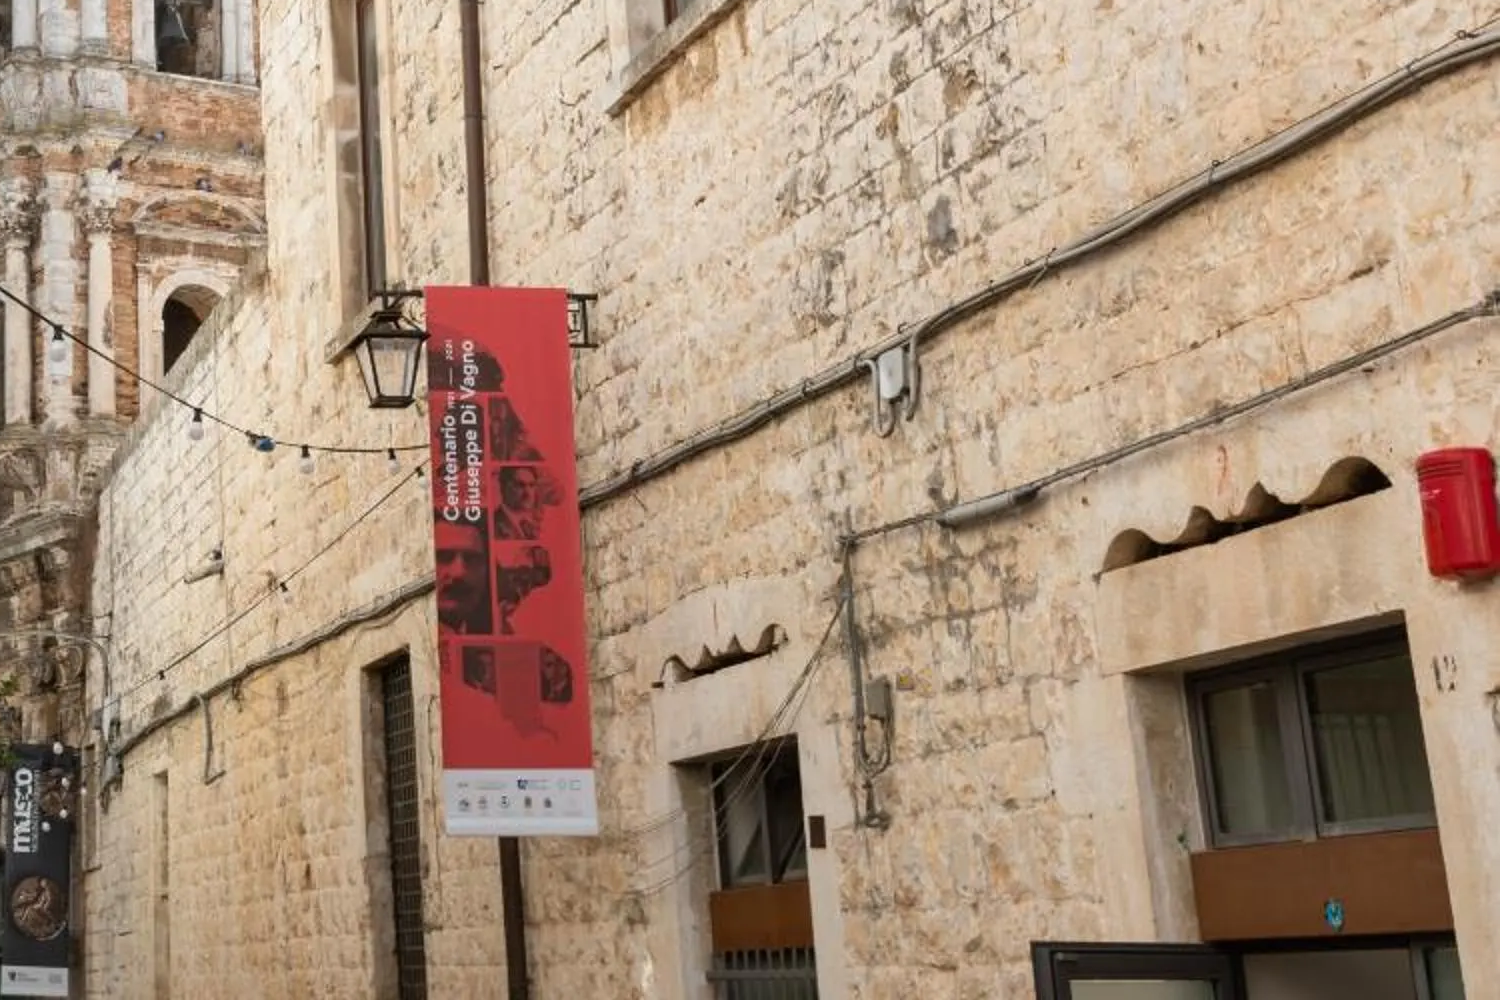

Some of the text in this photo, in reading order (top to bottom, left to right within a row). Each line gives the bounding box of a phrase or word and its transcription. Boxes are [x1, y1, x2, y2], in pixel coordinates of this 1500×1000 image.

[440, 415, 460, 521] Centenario
[460, 340, 483, 521] Giuseppe Di Vagno
